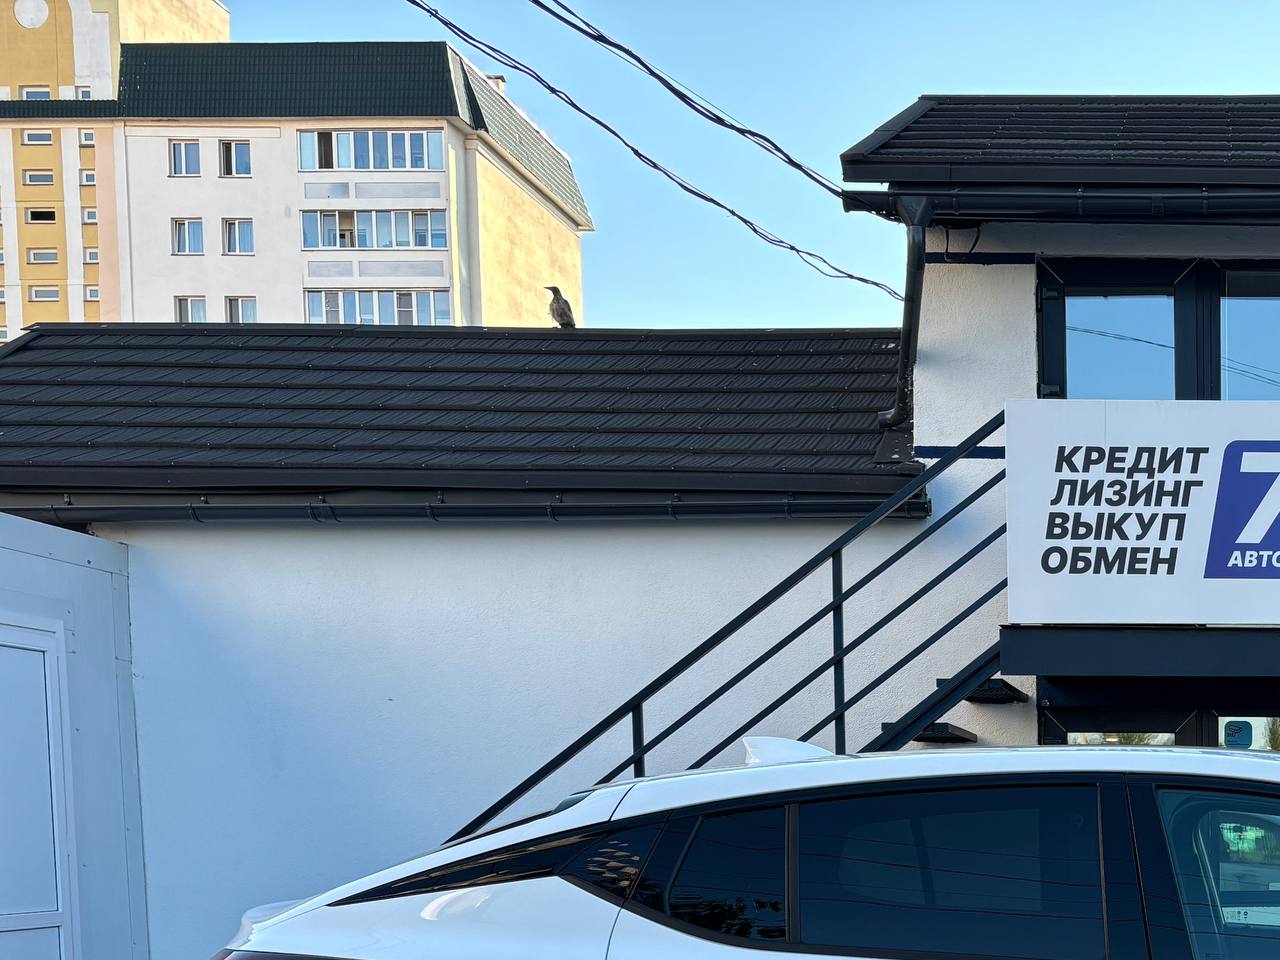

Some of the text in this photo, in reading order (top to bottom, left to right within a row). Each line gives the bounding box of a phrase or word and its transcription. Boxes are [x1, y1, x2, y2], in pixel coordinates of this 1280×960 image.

[1055, 445, 1208, 479] КРЕДИТ
[1050, 480, 1203, 507] ЛИЗИНГ
[1045, 512, 1187, 541] ВЫКУП
[1041, 546, 1178, 575] ОБМЕН
